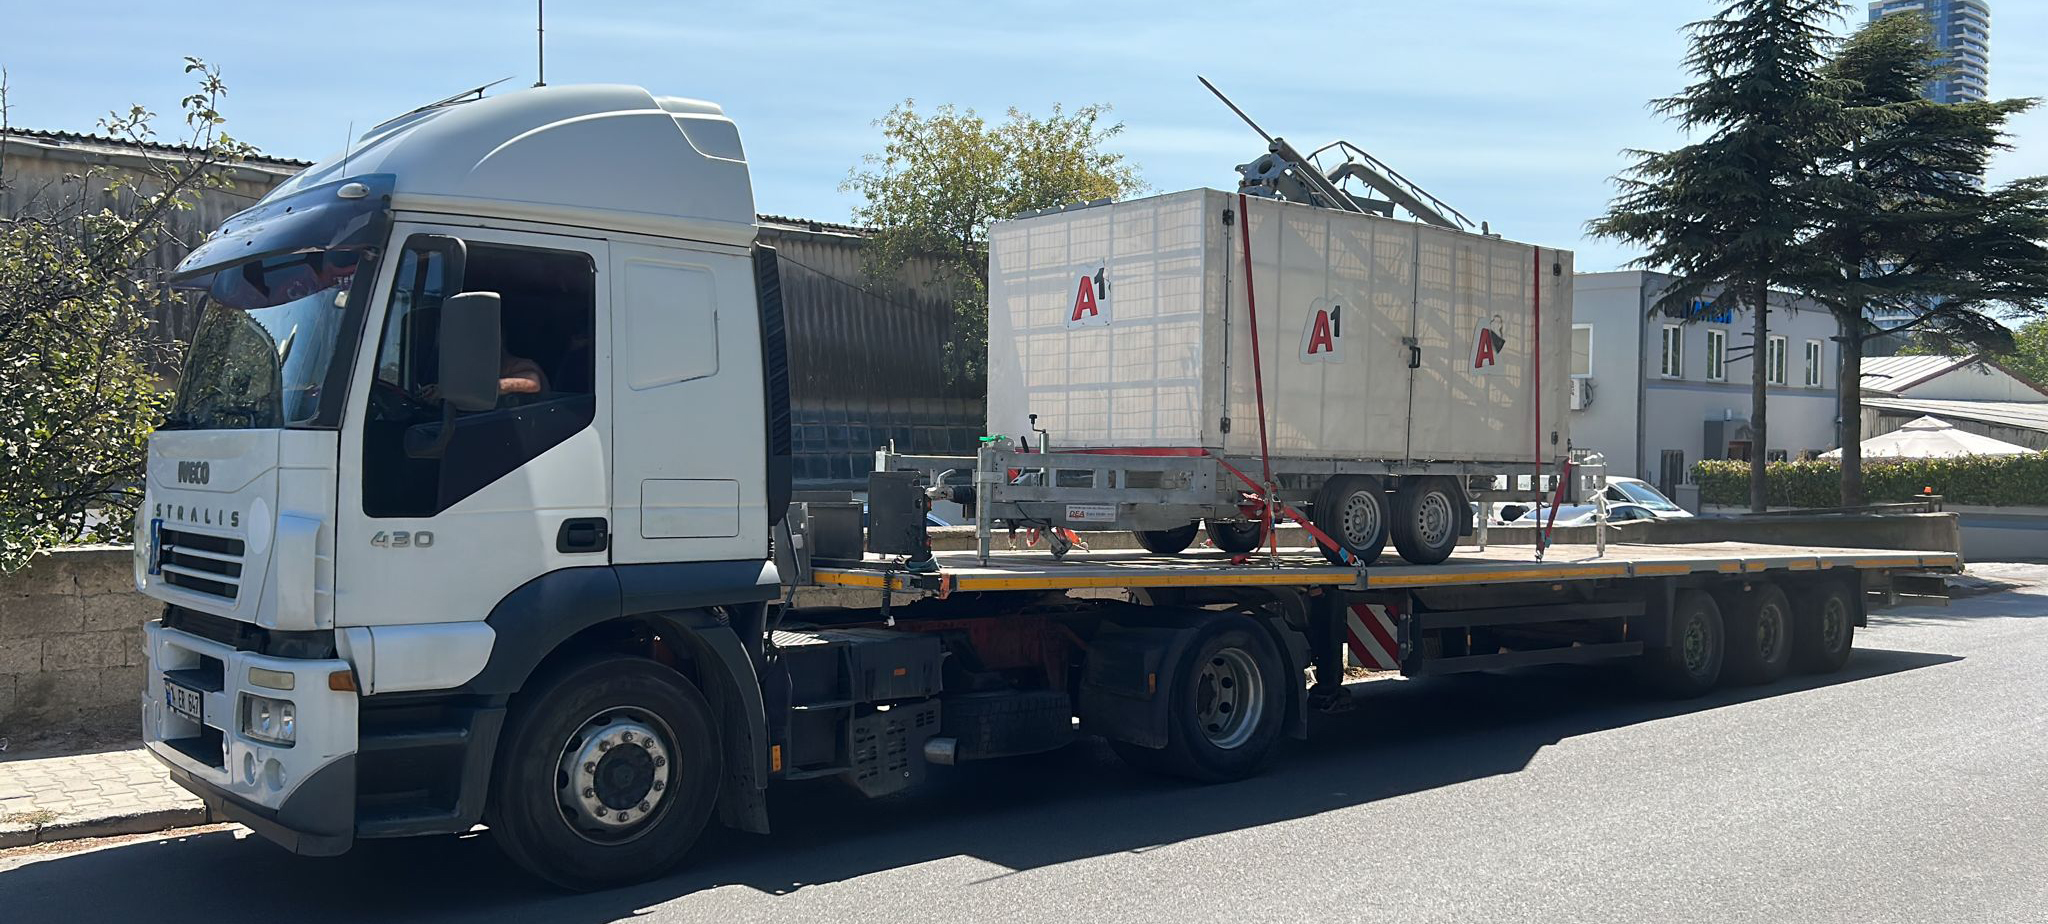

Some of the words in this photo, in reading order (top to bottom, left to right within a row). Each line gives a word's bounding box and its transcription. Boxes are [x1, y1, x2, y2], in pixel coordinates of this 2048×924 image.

[1072, 267, 1105, 321] A1
[1308, 305, 1341, 354] A1
[1475, 327, 1500, 368] A
[178, 461, 210, 484] IVECO
[156, 503, 239, 527] STRALIS
[370, 530, 434, 548] 430
[188, 693, 199, 715] 647
